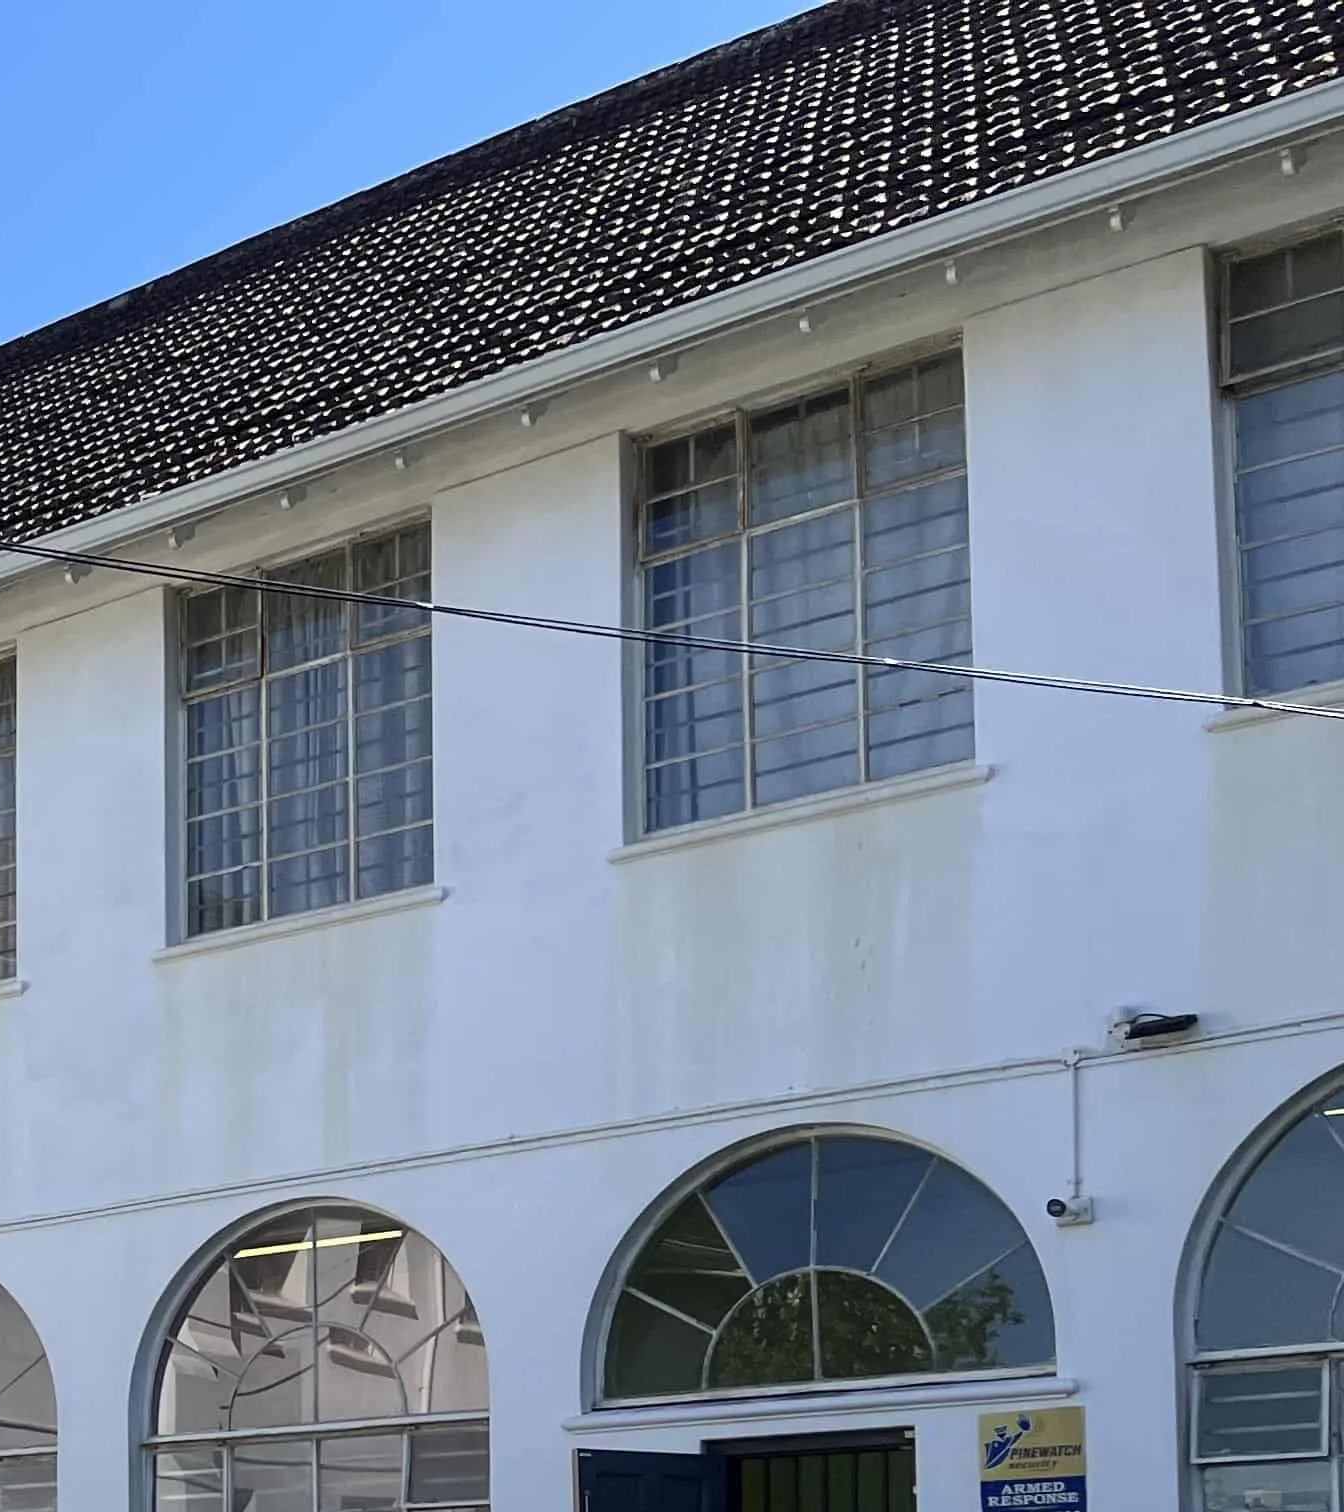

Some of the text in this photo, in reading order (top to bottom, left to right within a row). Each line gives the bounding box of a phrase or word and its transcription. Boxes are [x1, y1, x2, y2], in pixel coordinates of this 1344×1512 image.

[1009, 1444, 1082, 1460] PINEWATCH
[1001, 1481, 1065, 1495] ARMED
[987, 1492, 1080, 1507] RESPONSE
